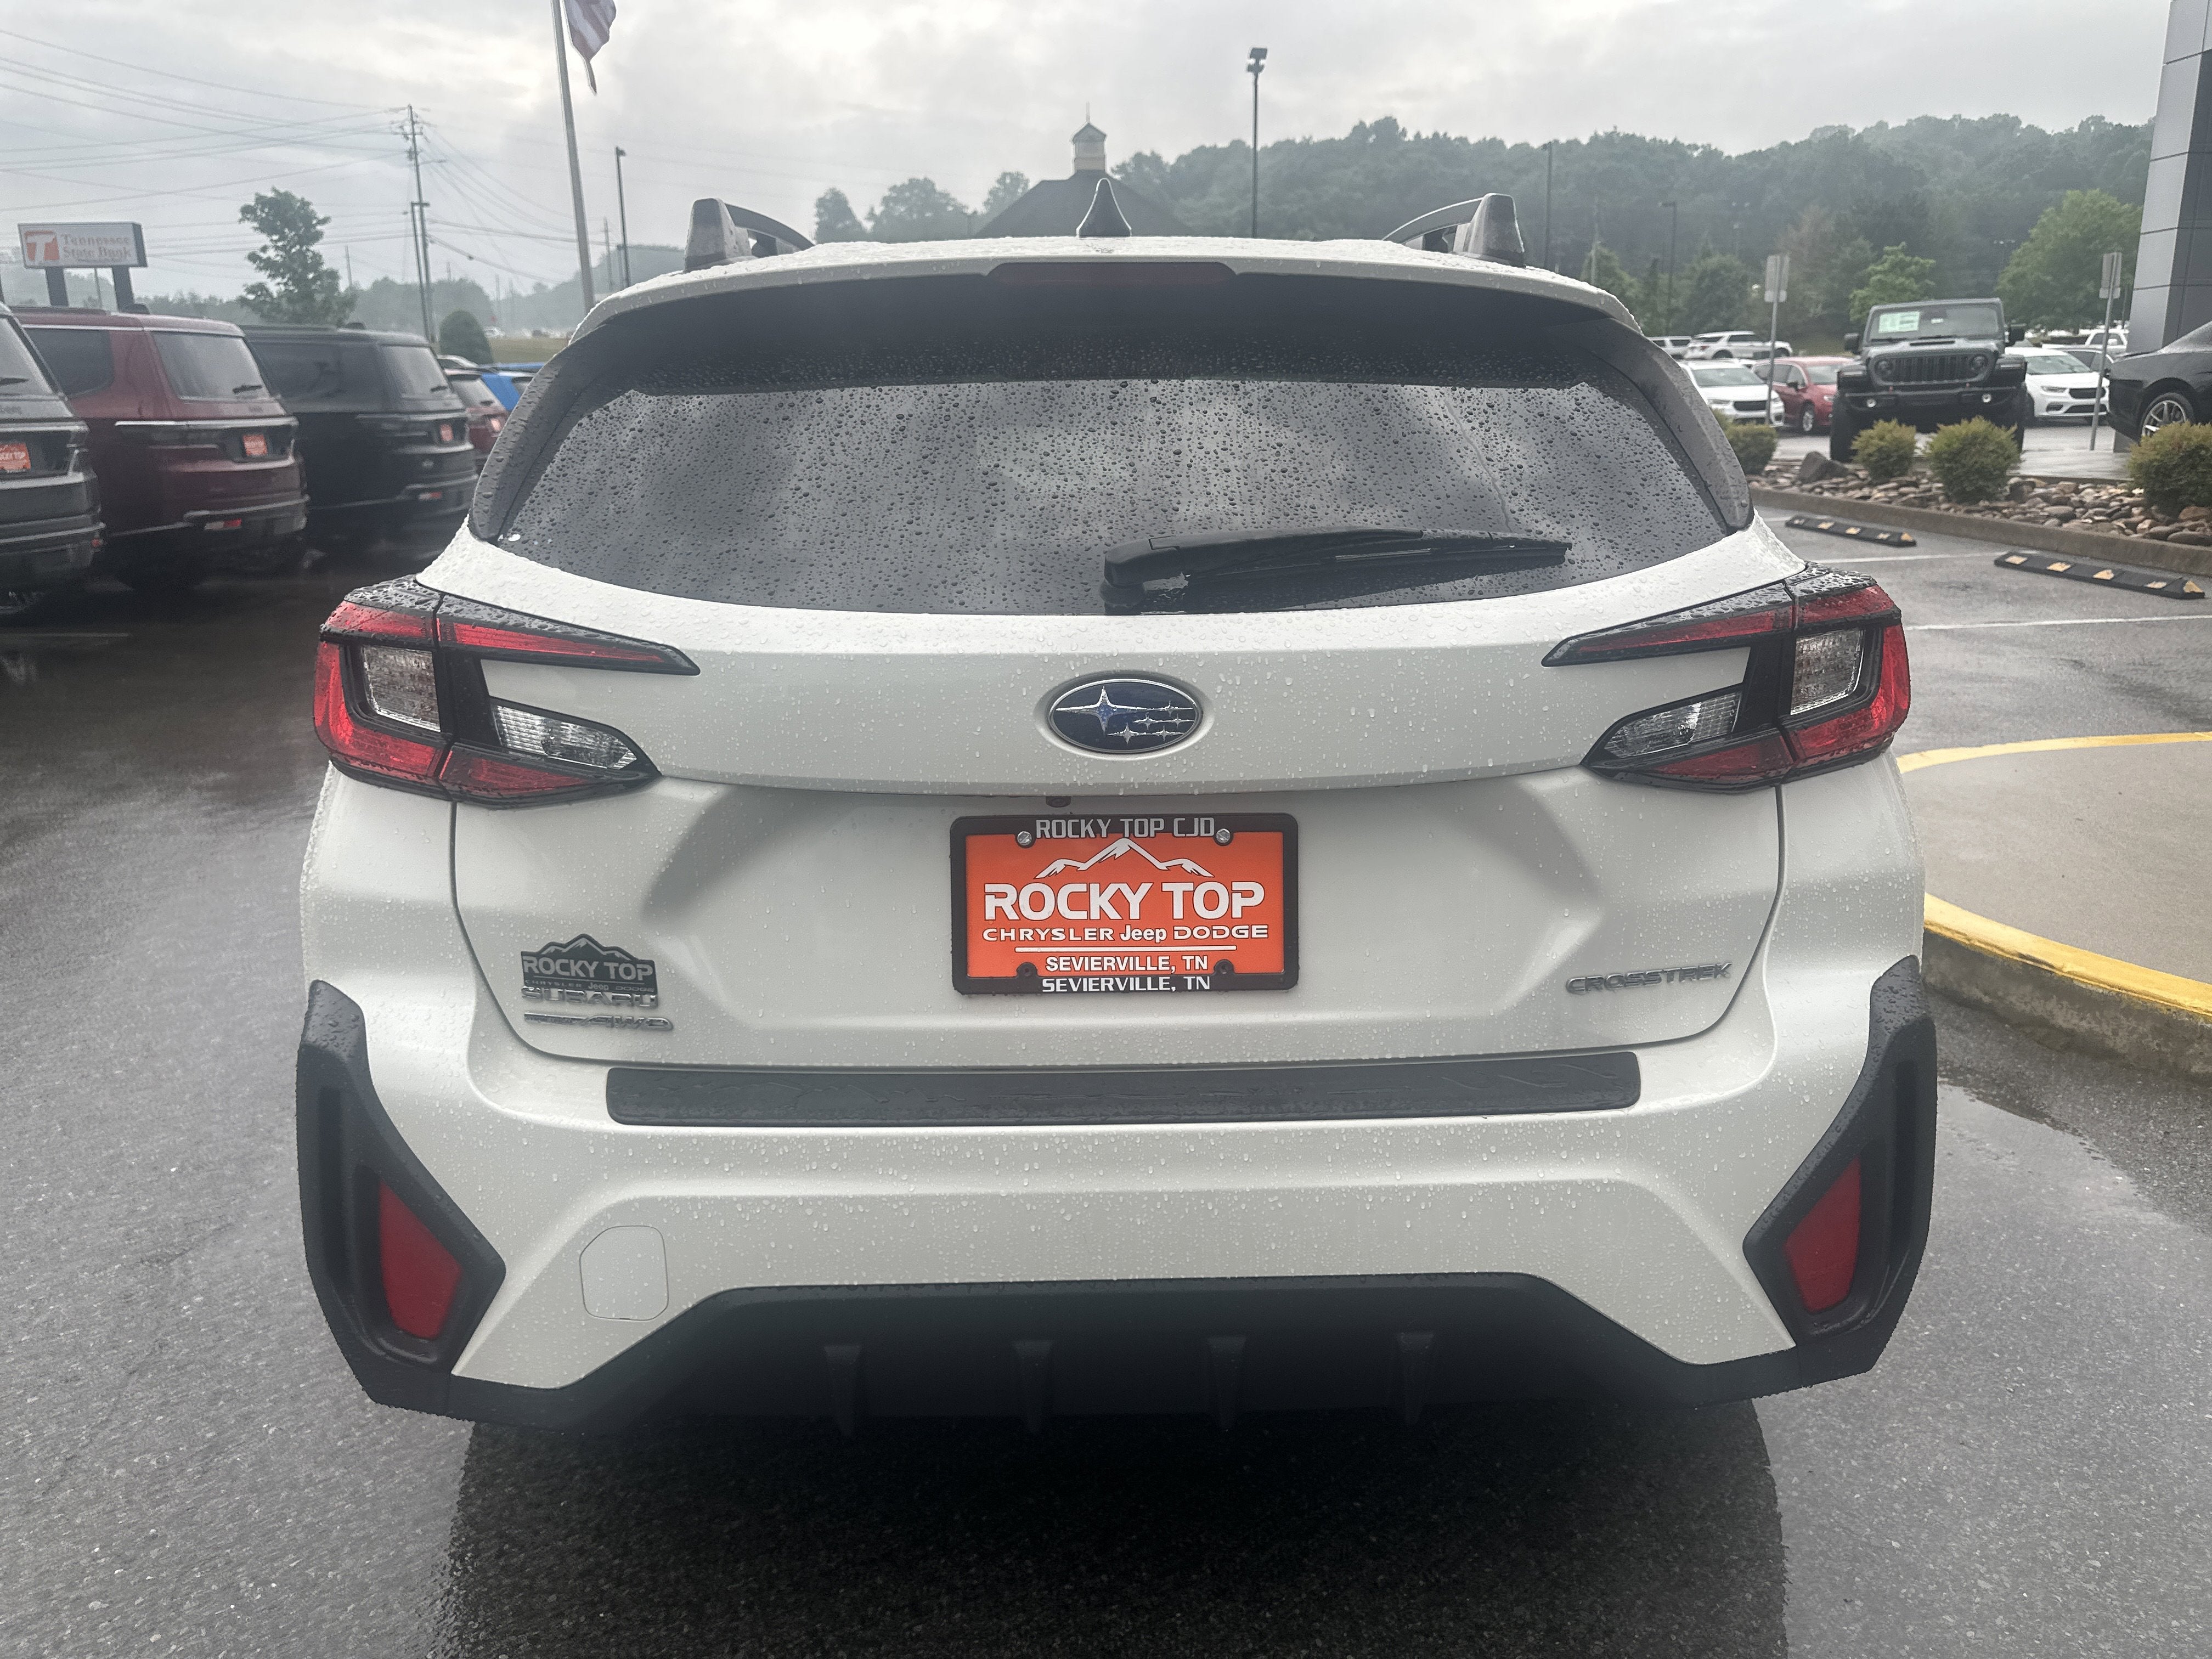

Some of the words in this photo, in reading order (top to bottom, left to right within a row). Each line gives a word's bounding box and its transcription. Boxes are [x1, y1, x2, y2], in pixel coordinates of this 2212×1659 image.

[1036, 819, 1110, 838] ROCKY
[1120, 819, 1164, 838] TOP
[1173, 817, 1215, 837] CJD
[984, 882, 1154, 921] ROCKY
[1161, 881, 1266, 919] TOP
[983, 927, 1114, 941] CHRYSLER
[1120, 926, 1168, 944] Jeep
[1173, 925, 1268, 940] DODGE
[522, 956, 599, 978] ROCKY
[603, 961, 654, 981] TOP
[1045, 956, 1175, 974] SEVIERVILLE,
[1182, 955, 1209, 971] TN
[524, 979, 582, 988] CHRYSLER
[588, 981, 610, 991] Jeep
[1042, 976, 1176, 992] SEVIERVILLE,
[1187, 975, 1211, 990] TN
[1566, 962, 1733, 994] CROSSTREK
